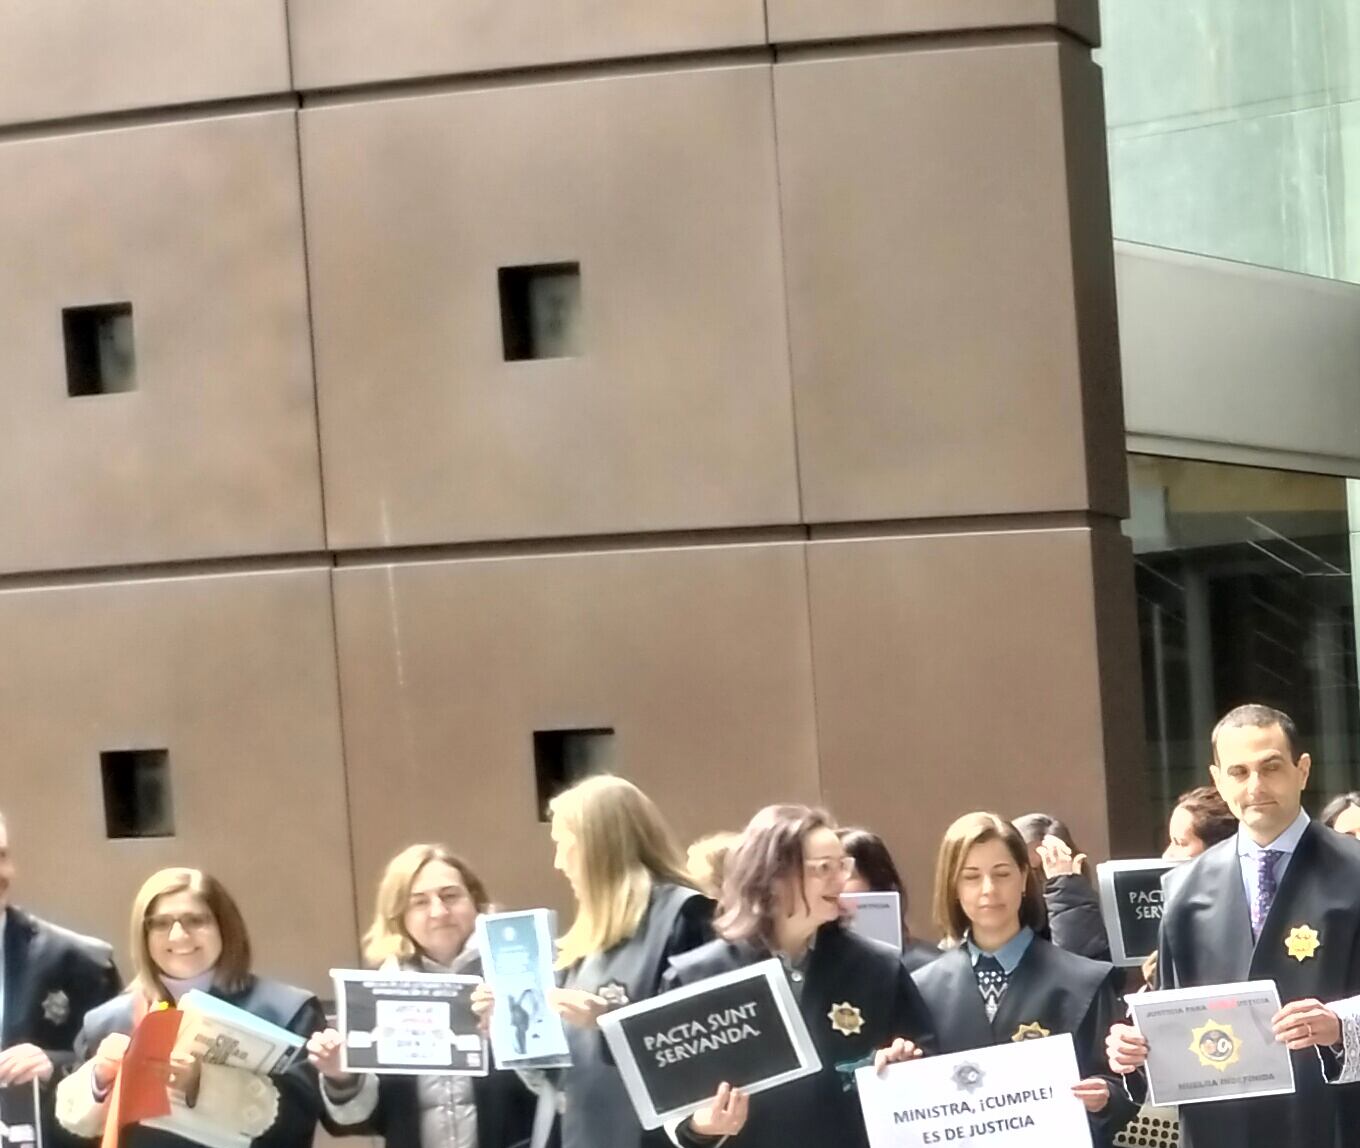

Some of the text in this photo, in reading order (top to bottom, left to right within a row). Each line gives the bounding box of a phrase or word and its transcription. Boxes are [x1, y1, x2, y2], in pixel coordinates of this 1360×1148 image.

[1128, 890, 1164, 904] PACT
[643, 1001, 758, 1051] PACTA SUNT
[655, 1023, 761, 1068] SERVANDA.
[893, 1085, 1053, 1125] MINISTRA, ¡CUMPLE!
[922, 1114, 1035, 1144] ES DE JUSTICIA
